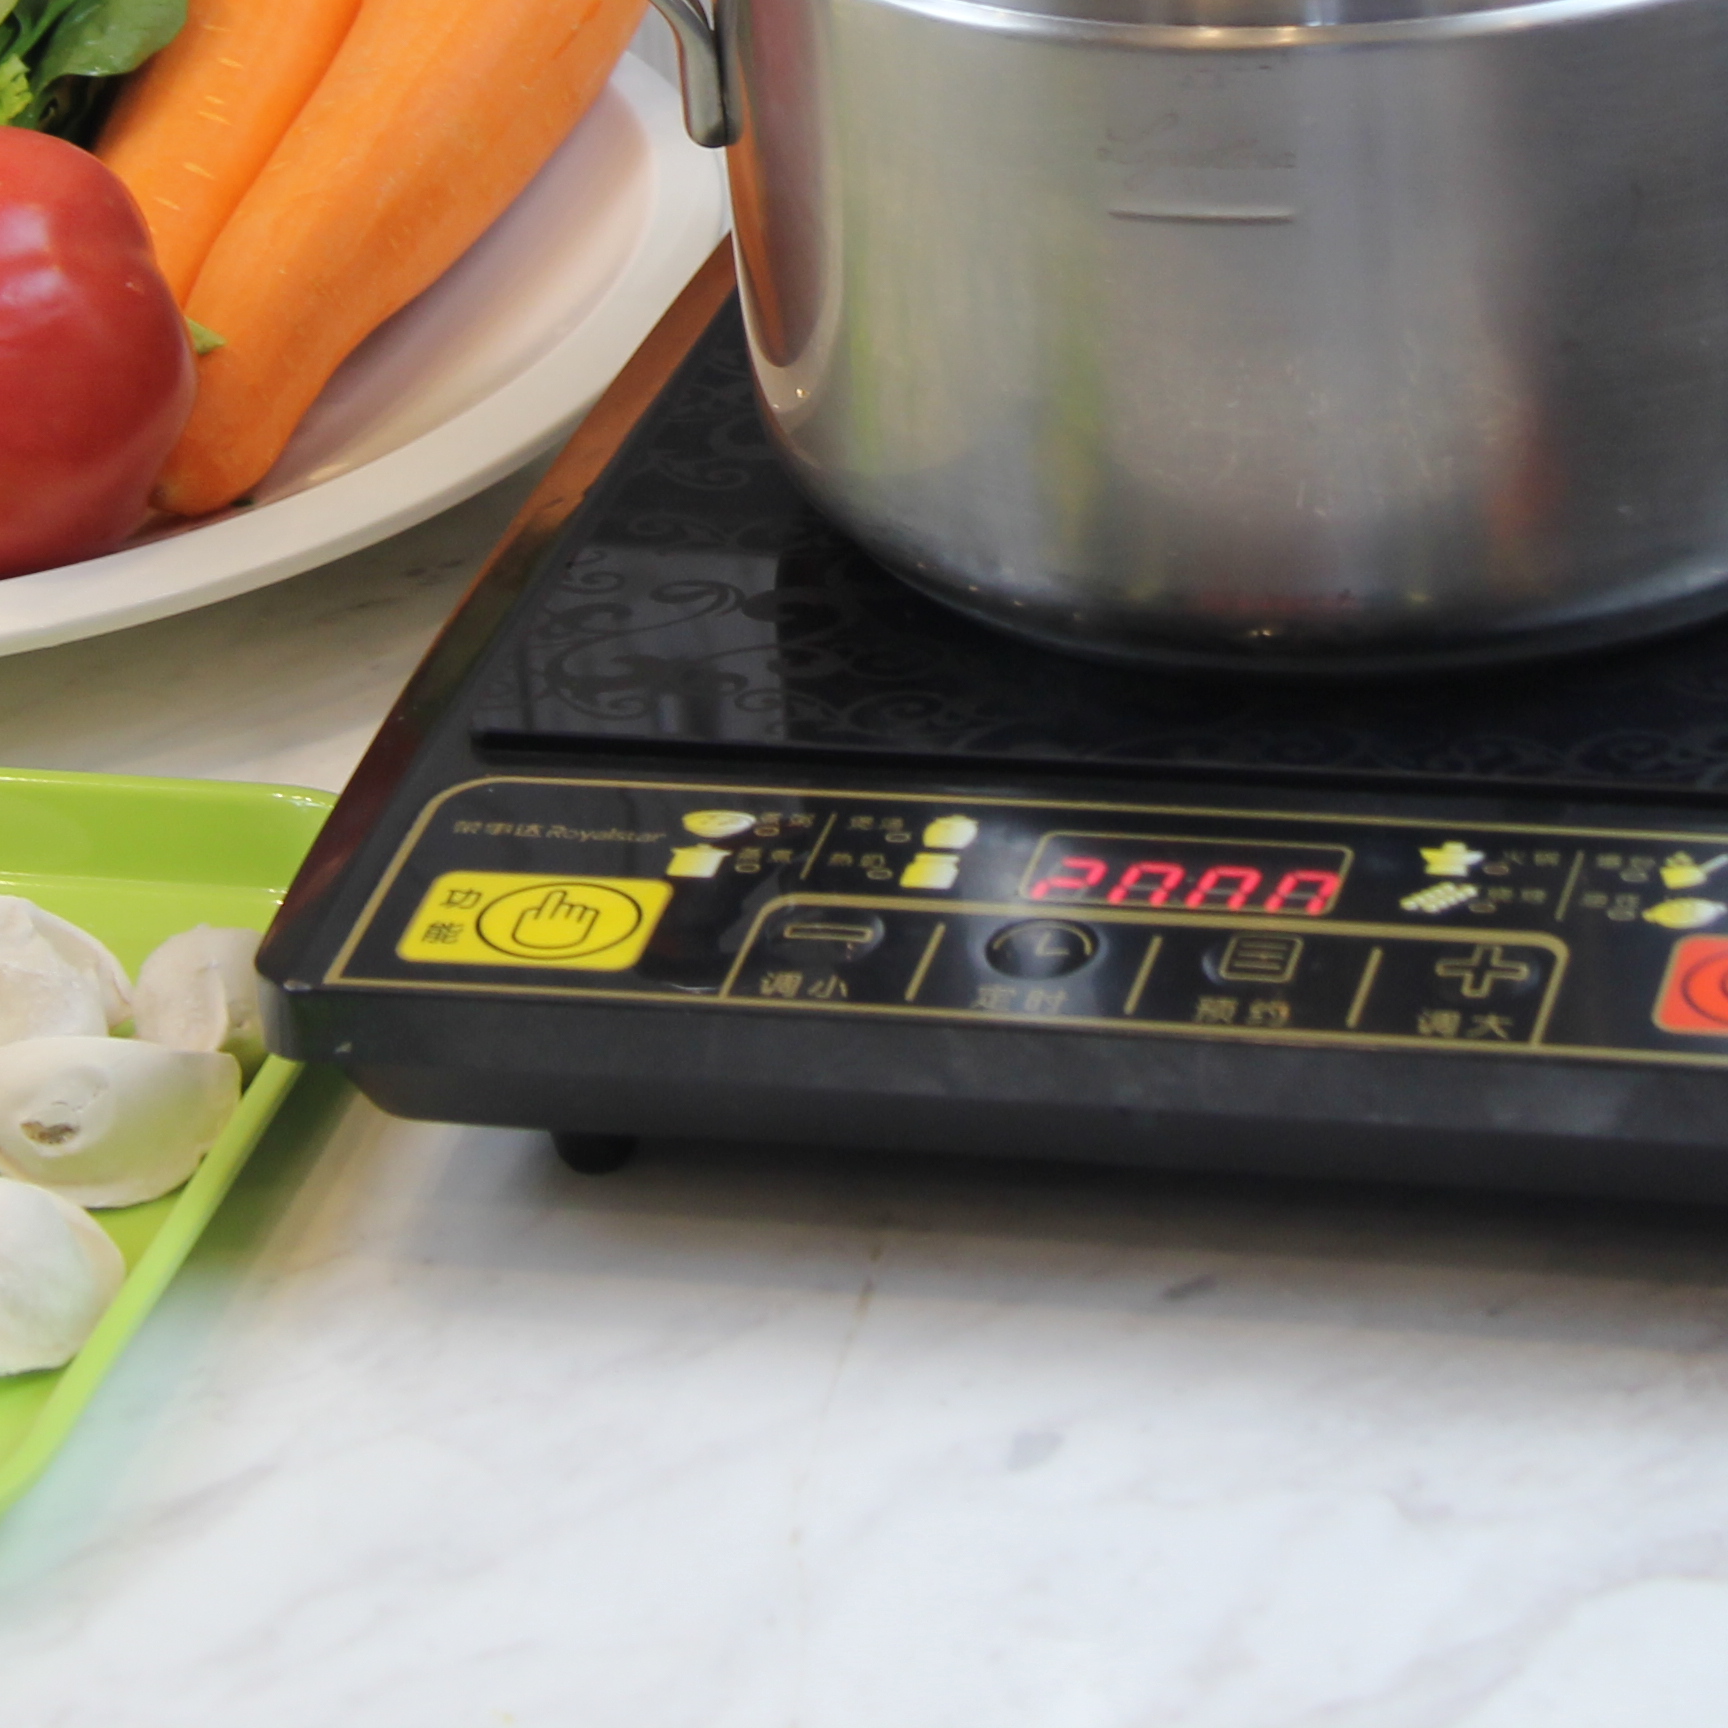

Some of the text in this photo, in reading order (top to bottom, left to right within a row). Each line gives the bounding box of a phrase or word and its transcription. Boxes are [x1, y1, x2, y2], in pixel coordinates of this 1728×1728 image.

[418, 886, 483, 945] 功能
[760, 970, 849, 999] 调小
[976, 984, 1070, 1015] 定时
[1417, 1008, 1514, 1041] 调大
